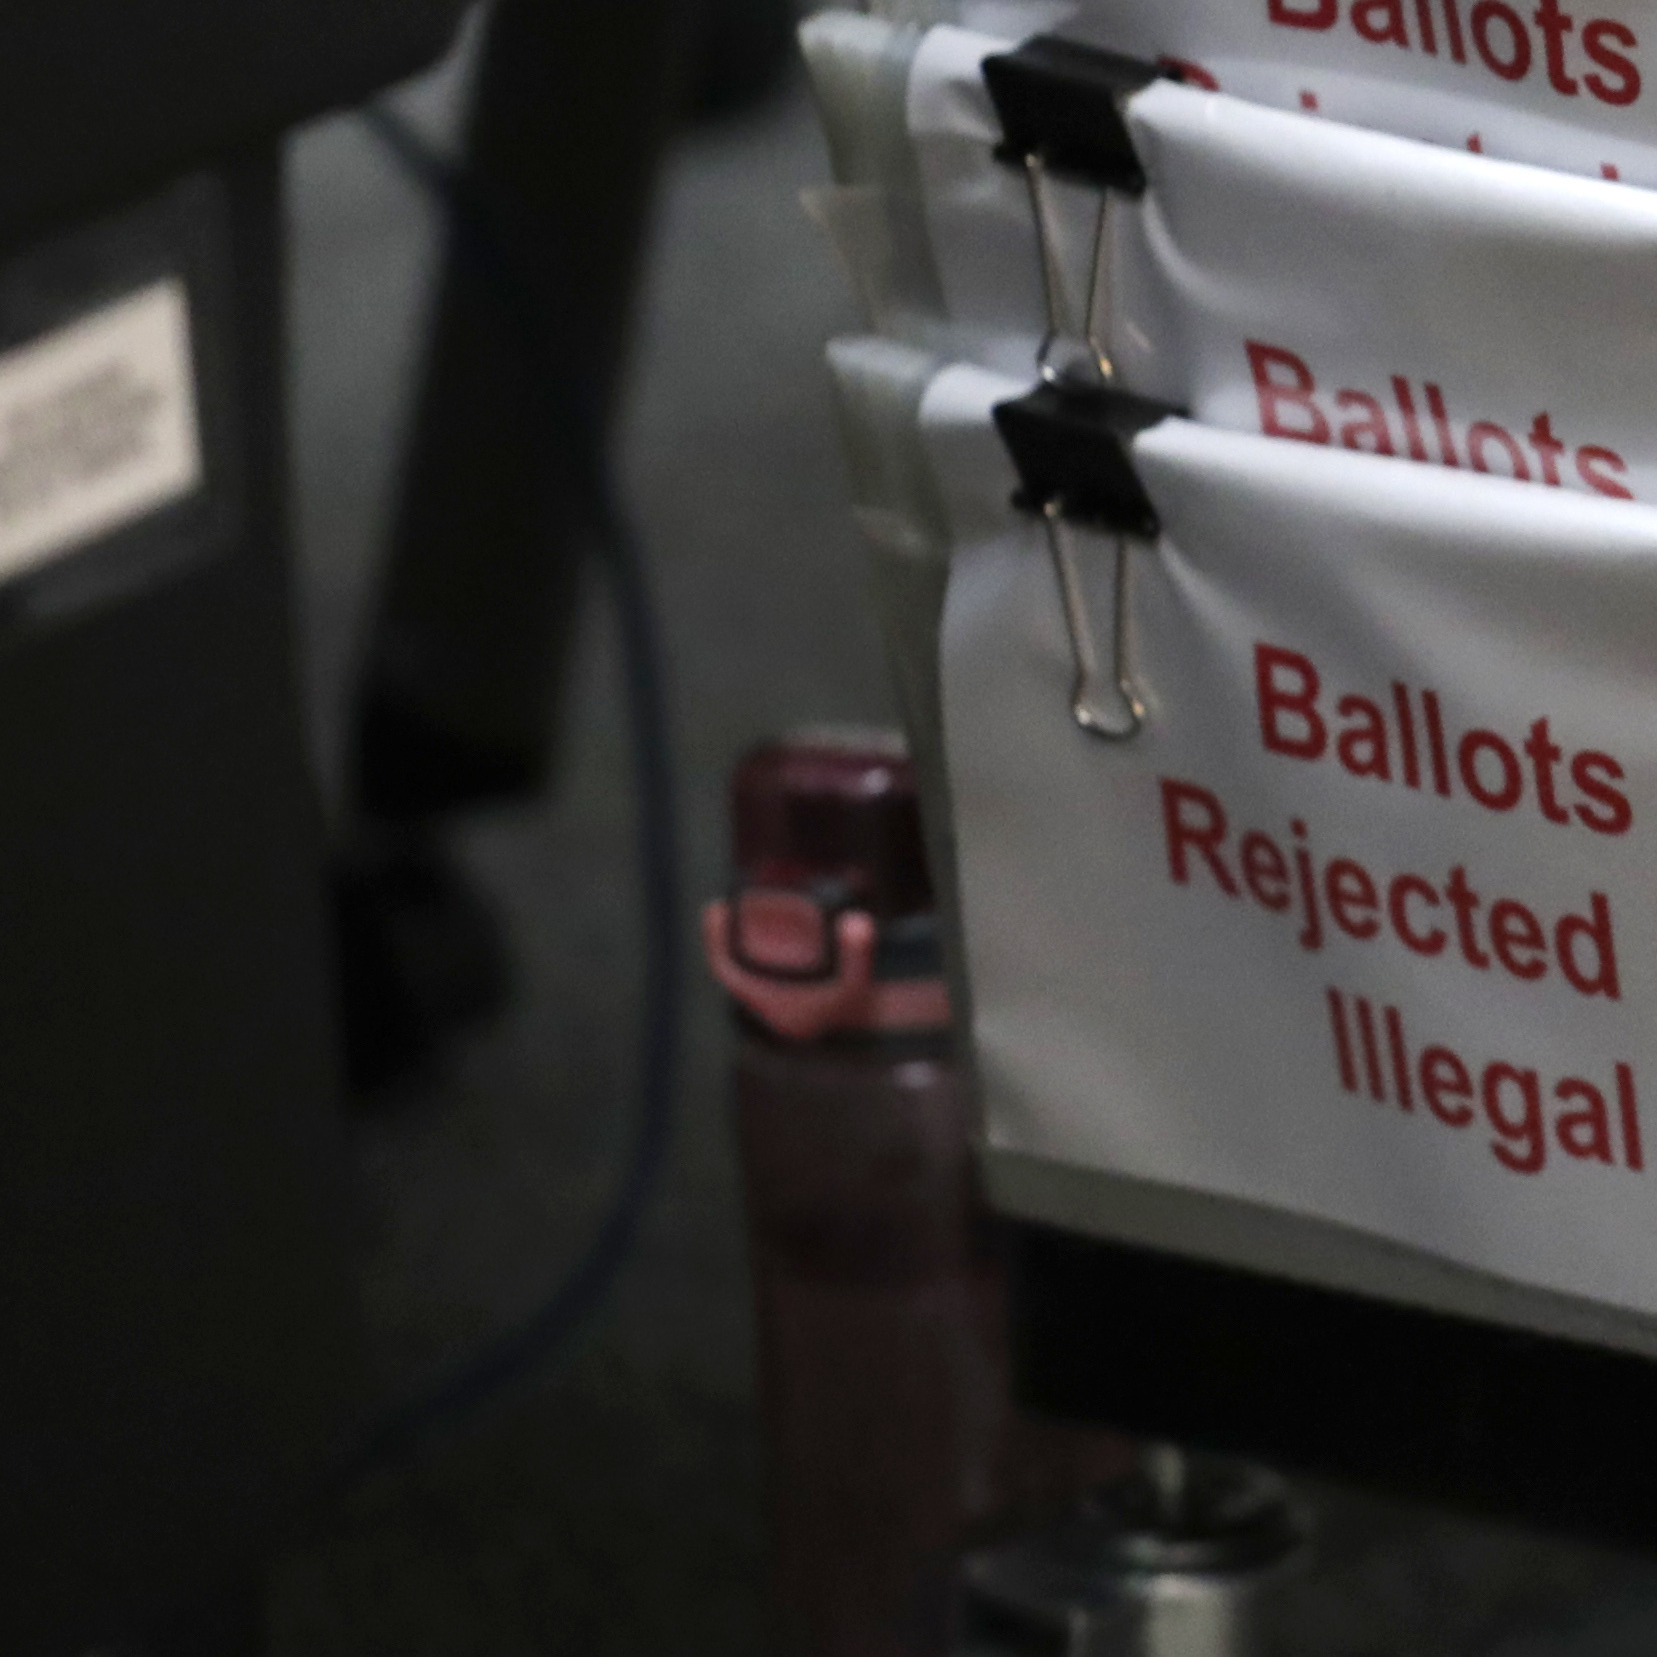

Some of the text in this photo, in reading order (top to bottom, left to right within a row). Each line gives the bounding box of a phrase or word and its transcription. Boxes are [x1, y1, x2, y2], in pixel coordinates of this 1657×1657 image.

[1243, 339, 1638, 502] Ballots
[1252, 640, 1636, 841] Ballots
[1158, 776, 1623, 1003] Rejected
[1325, 987, 1648, 1176] Illegal
